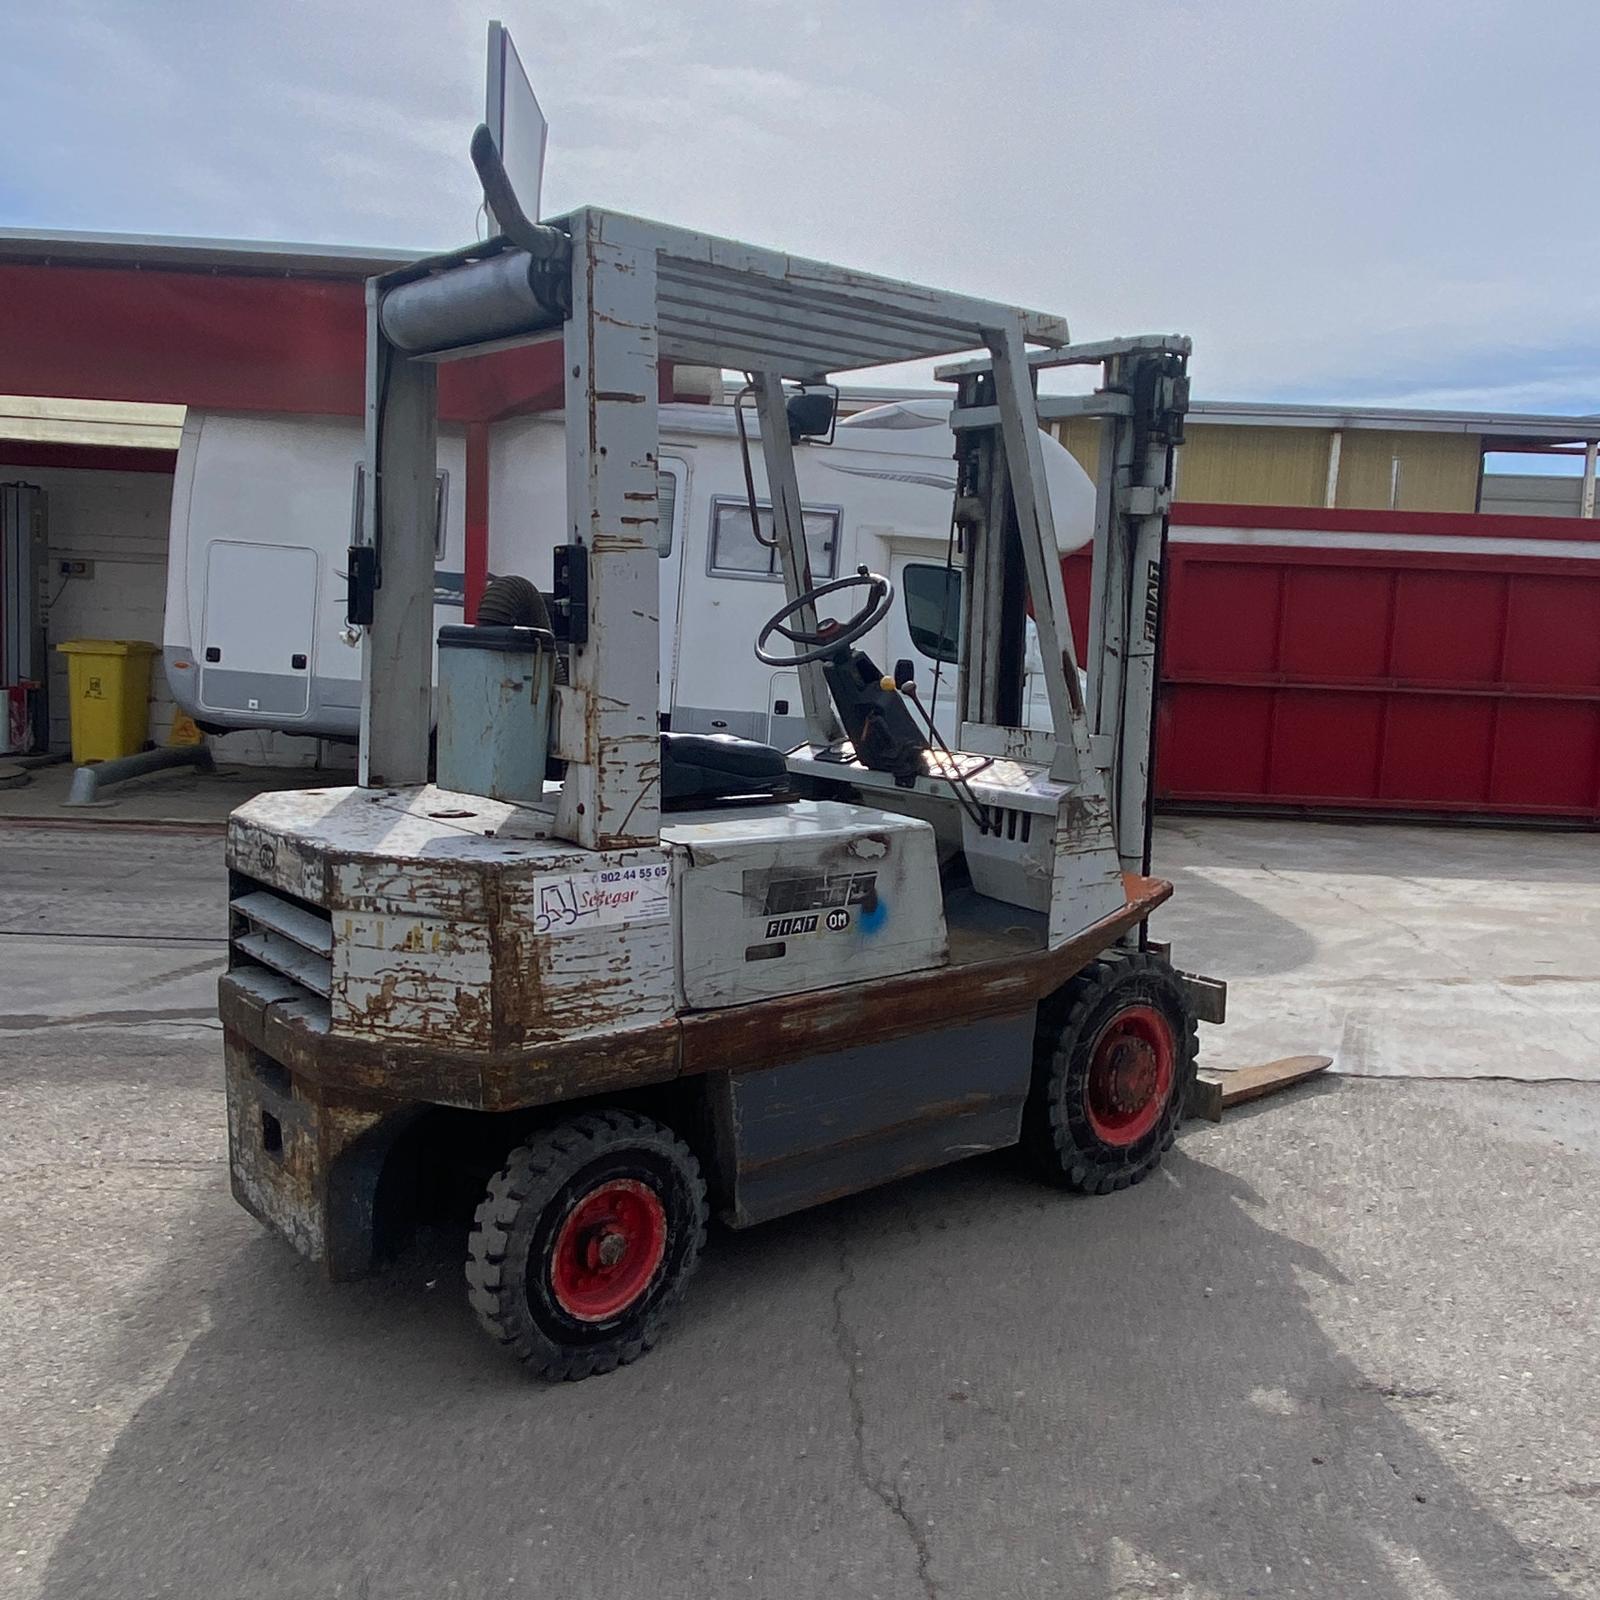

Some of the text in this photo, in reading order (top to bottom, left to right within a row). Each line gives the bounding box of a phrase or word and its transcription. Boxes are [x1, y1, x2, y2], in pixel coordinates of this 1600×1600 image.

[1145, 563, 1160, 640] FIAT
[601, 866, 668, 883] 902 44 55 05
[767, 911, 849, 937] FIAT OM
